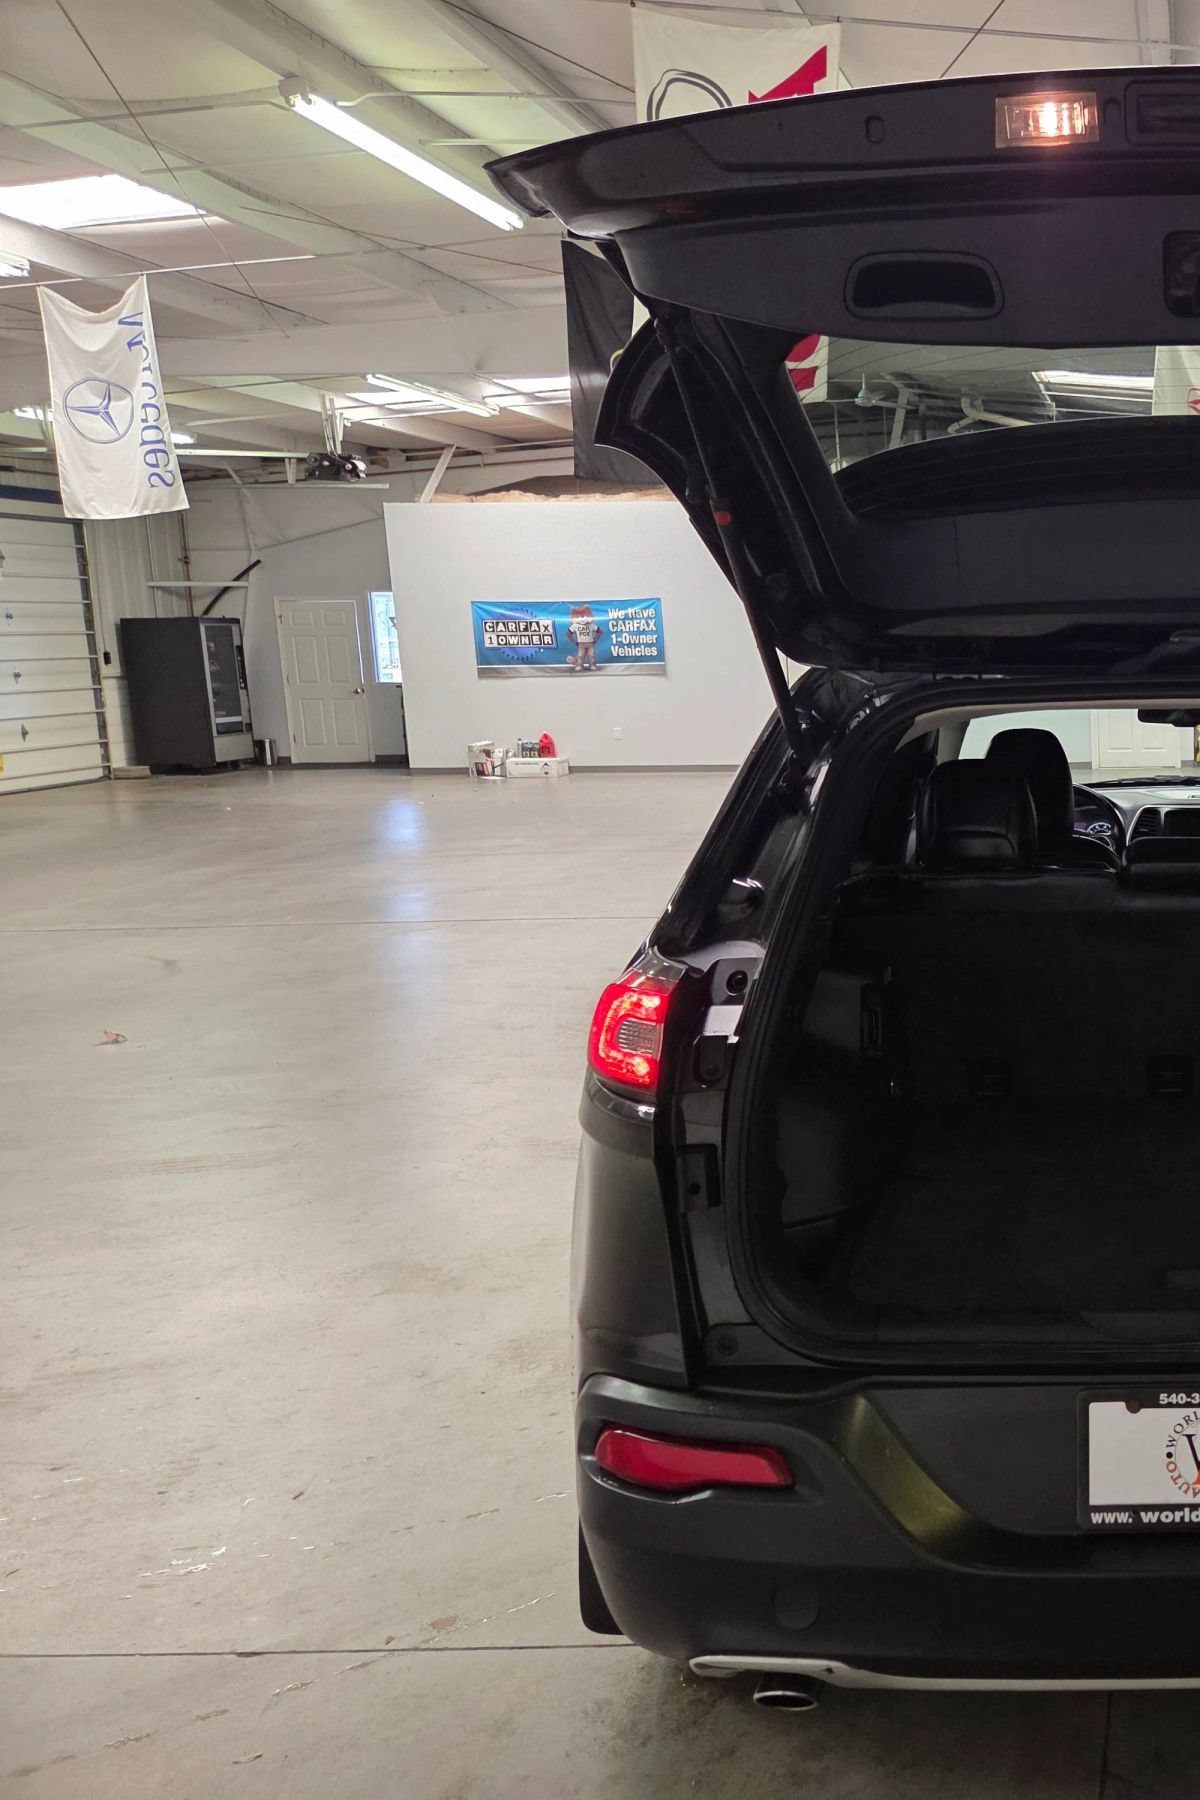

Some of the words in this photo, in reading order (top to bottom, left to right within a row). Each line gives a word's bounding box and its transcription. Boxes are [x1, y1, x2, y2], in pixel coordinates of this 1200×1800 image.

[608, 608, 625, 619] We
[484, 620, 551, 633] CARFAX
[609, 620, 657, 632] CARFAX
[611, 634, 657, 644] 1-Owner
[611, 646, 658, 658] Vehicles
